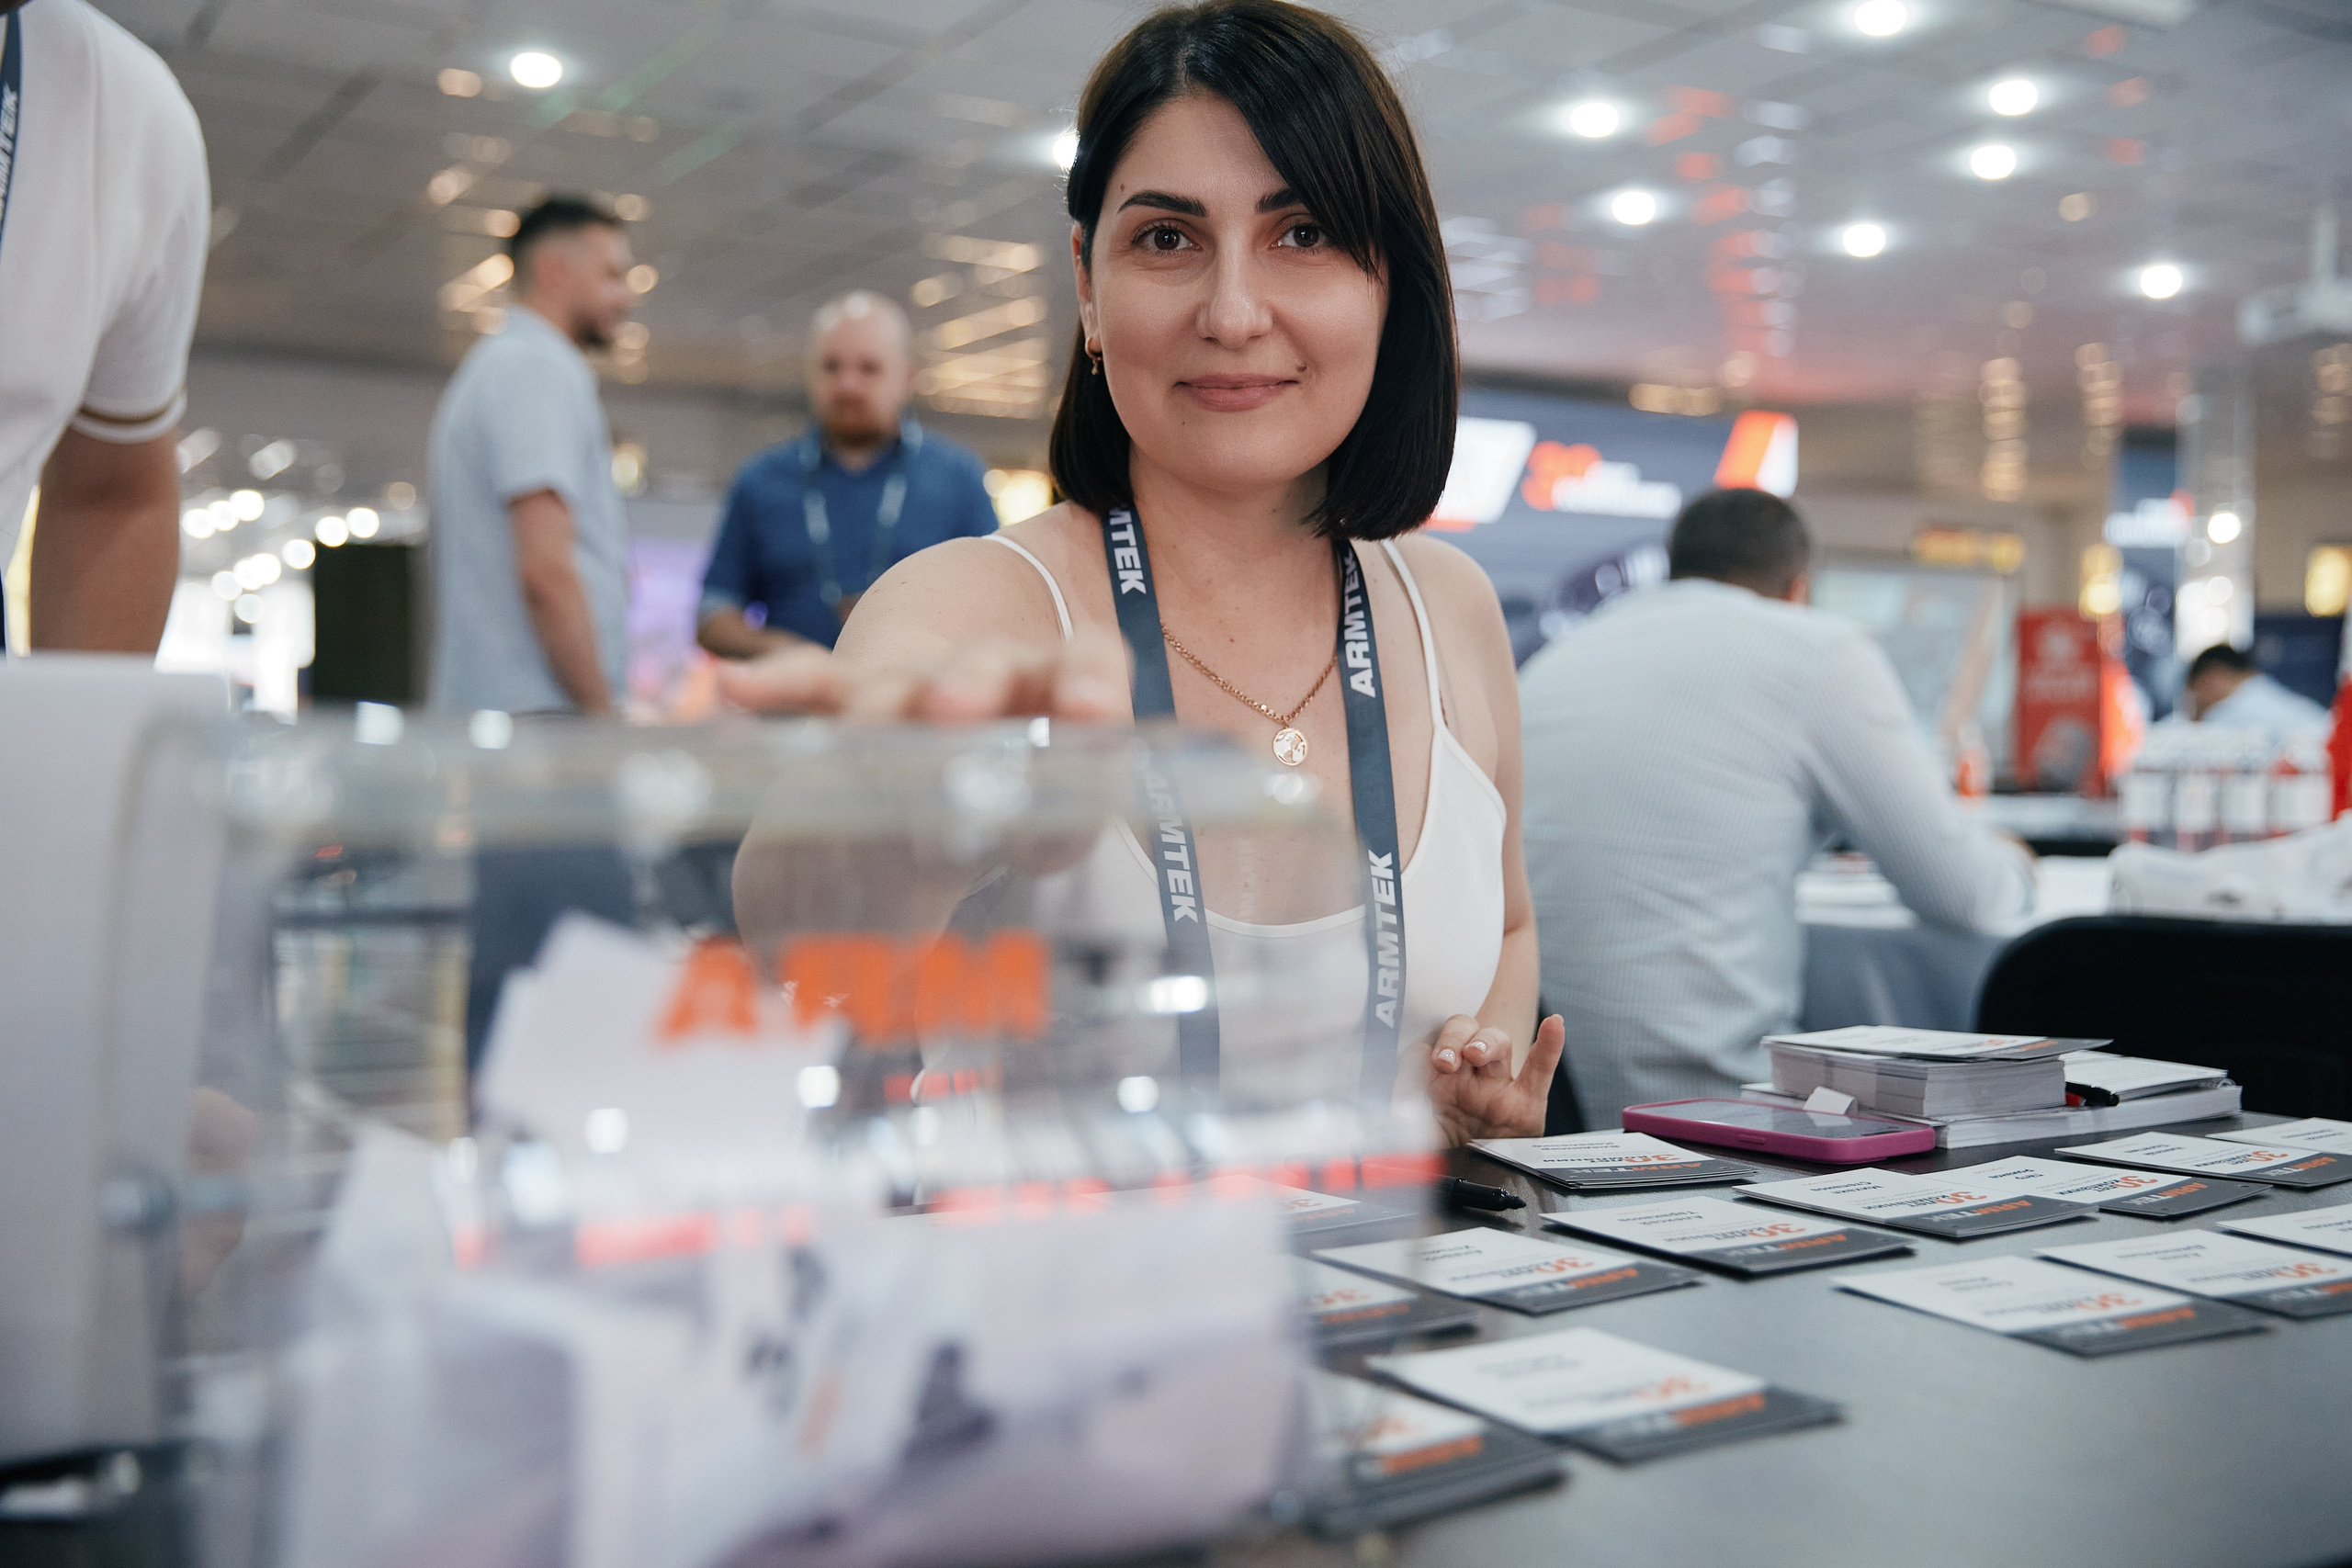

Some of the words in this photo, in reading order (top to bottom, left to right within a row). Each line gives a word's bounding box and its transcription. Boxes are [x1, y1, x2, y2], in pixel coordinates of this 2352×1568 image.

[1343, 553, 1377, 698] ARMTEK
[1145, 770, 1198, 923] ARMTEK
[1366, 850, 1400, 1030] ARMTEK
[1626, 1154, 1680, 1163] 30
[2251, 1150, 2289, 1163] 30
[1571, 1162, 1701, 1174] ARMTEK
[2262, 1156, 2338, 1177] ARMTEK
[2115, 1175, 2158, 1189] 30
[1864, 1195, 1950, 1211] компании
[1939, 1191, 1987, 1204] 30
[2122, 1182, 2208, 1206] ARMTEK
[1927, 1200, 2032, 1223] ARMTEK
[1748, 1223, 1806, 1237] 30
[1724, 1234, 1848, 1257] ARMTEK
